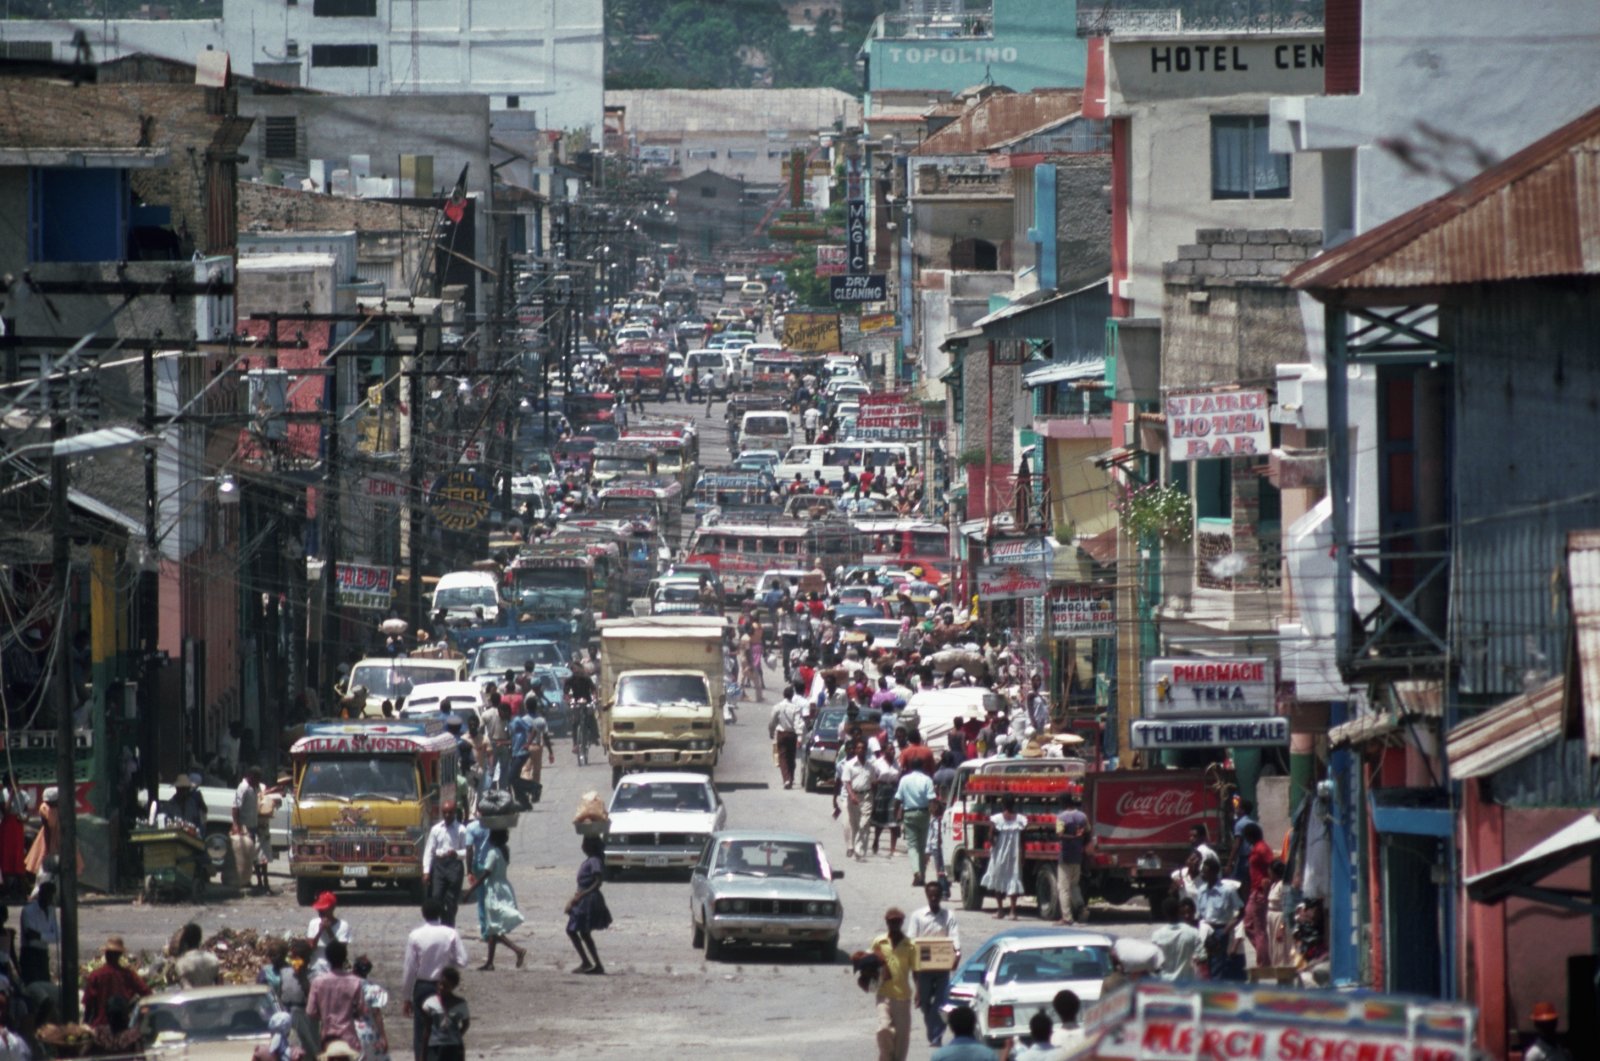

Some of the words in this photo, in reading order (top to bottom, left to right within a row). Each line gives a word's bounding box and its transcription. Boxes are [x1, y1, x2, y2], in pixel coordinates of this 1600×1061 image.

[889, 47, 1018, 64] TOPOLINO
[1151, 46, 1248, 73] HOTEL
[850, 204, 864, 269] MAGIC
[845, 276, 870, 287] DRY
[834, 287, 882, 300] CLEANING
[1173, 413, 1265, 438] HOTEL
[1186, 435, 1258, 459] BAR
[1052, 612, 1088, 623] HOTEL
[1173, 662, 1265, 683] PHARMACIE
[1154, 724, 1213, 744] CLINIQUE
[1219, 721, 1286, 742] MEDICALE
[303, 737, 348, 752] VILLA
[1115, 789, 1195, 817] Coca-Cola
[1141, 1021, 1265, 1060] MERCI
